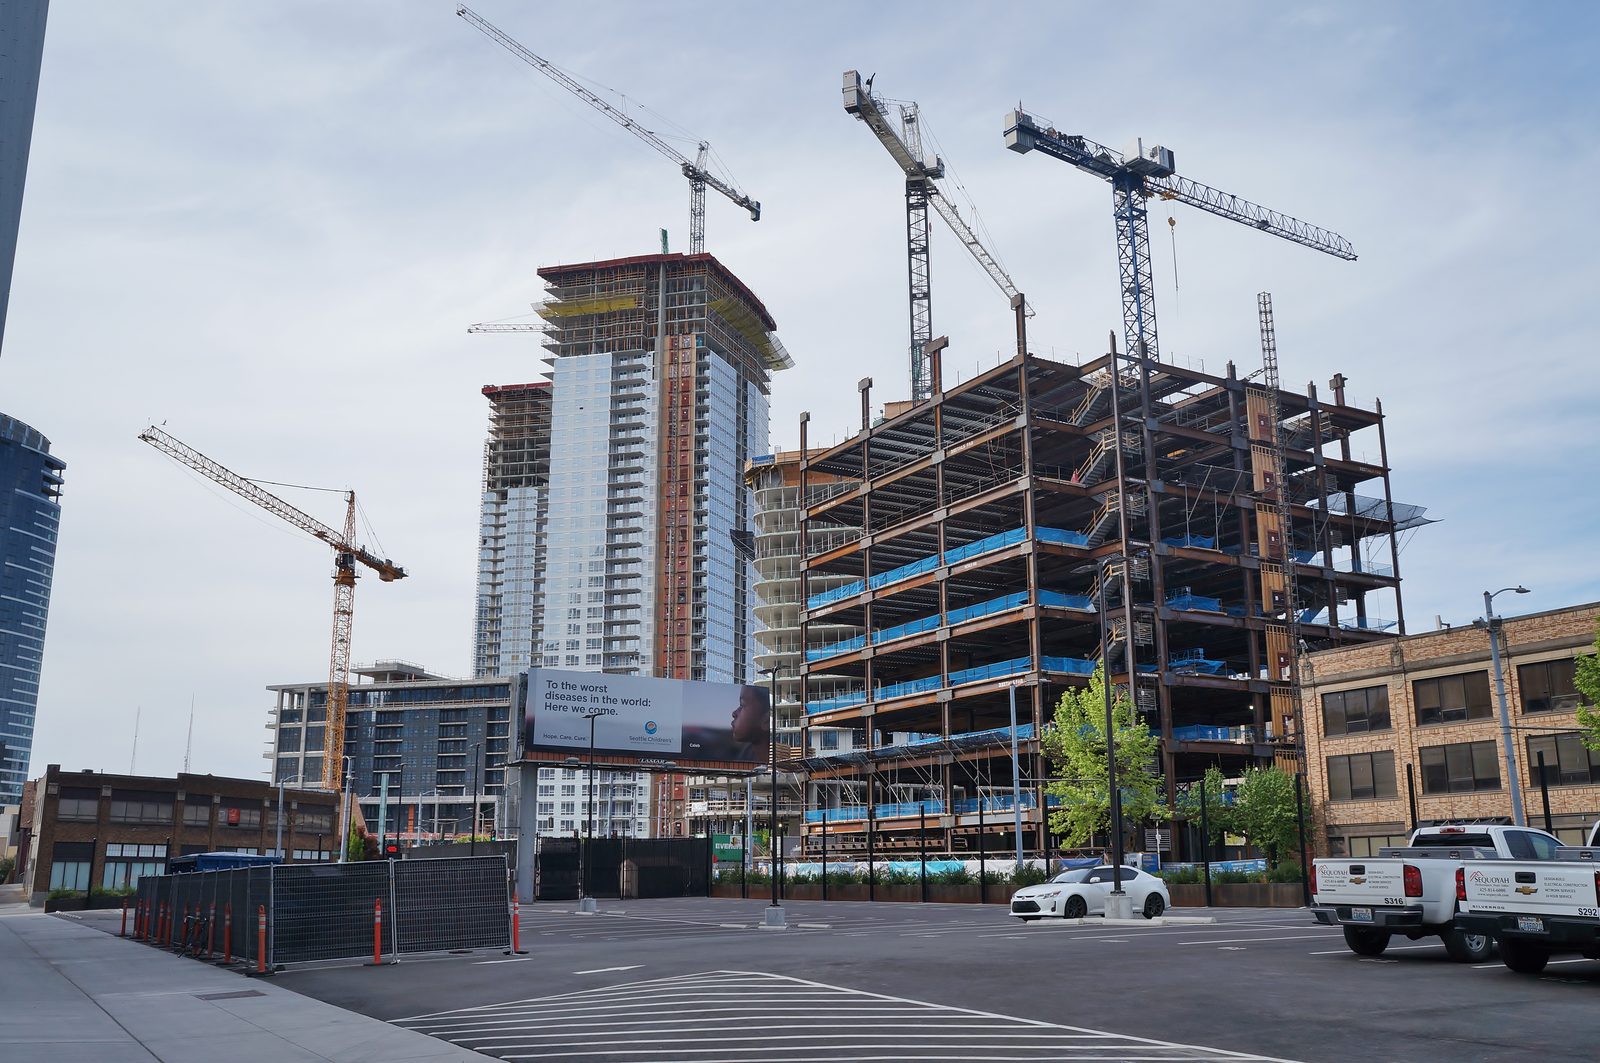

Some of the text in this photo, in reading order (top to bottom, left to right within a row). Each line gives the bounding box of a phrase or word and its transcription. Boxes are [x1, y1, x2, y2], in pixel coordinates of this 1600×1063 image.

[546, 680, 607, 693] To the worst
[545, 691, 651, 707] diseases in the world:
[544, 702, 618, 716] Here we come.
[543, 733, 558, 741] Hope.
[1474, 876, 1510, 884] SEQUOYAH
[1384, 897, 1404, 905] S316
[1577, 907, 1598, 916] S292
